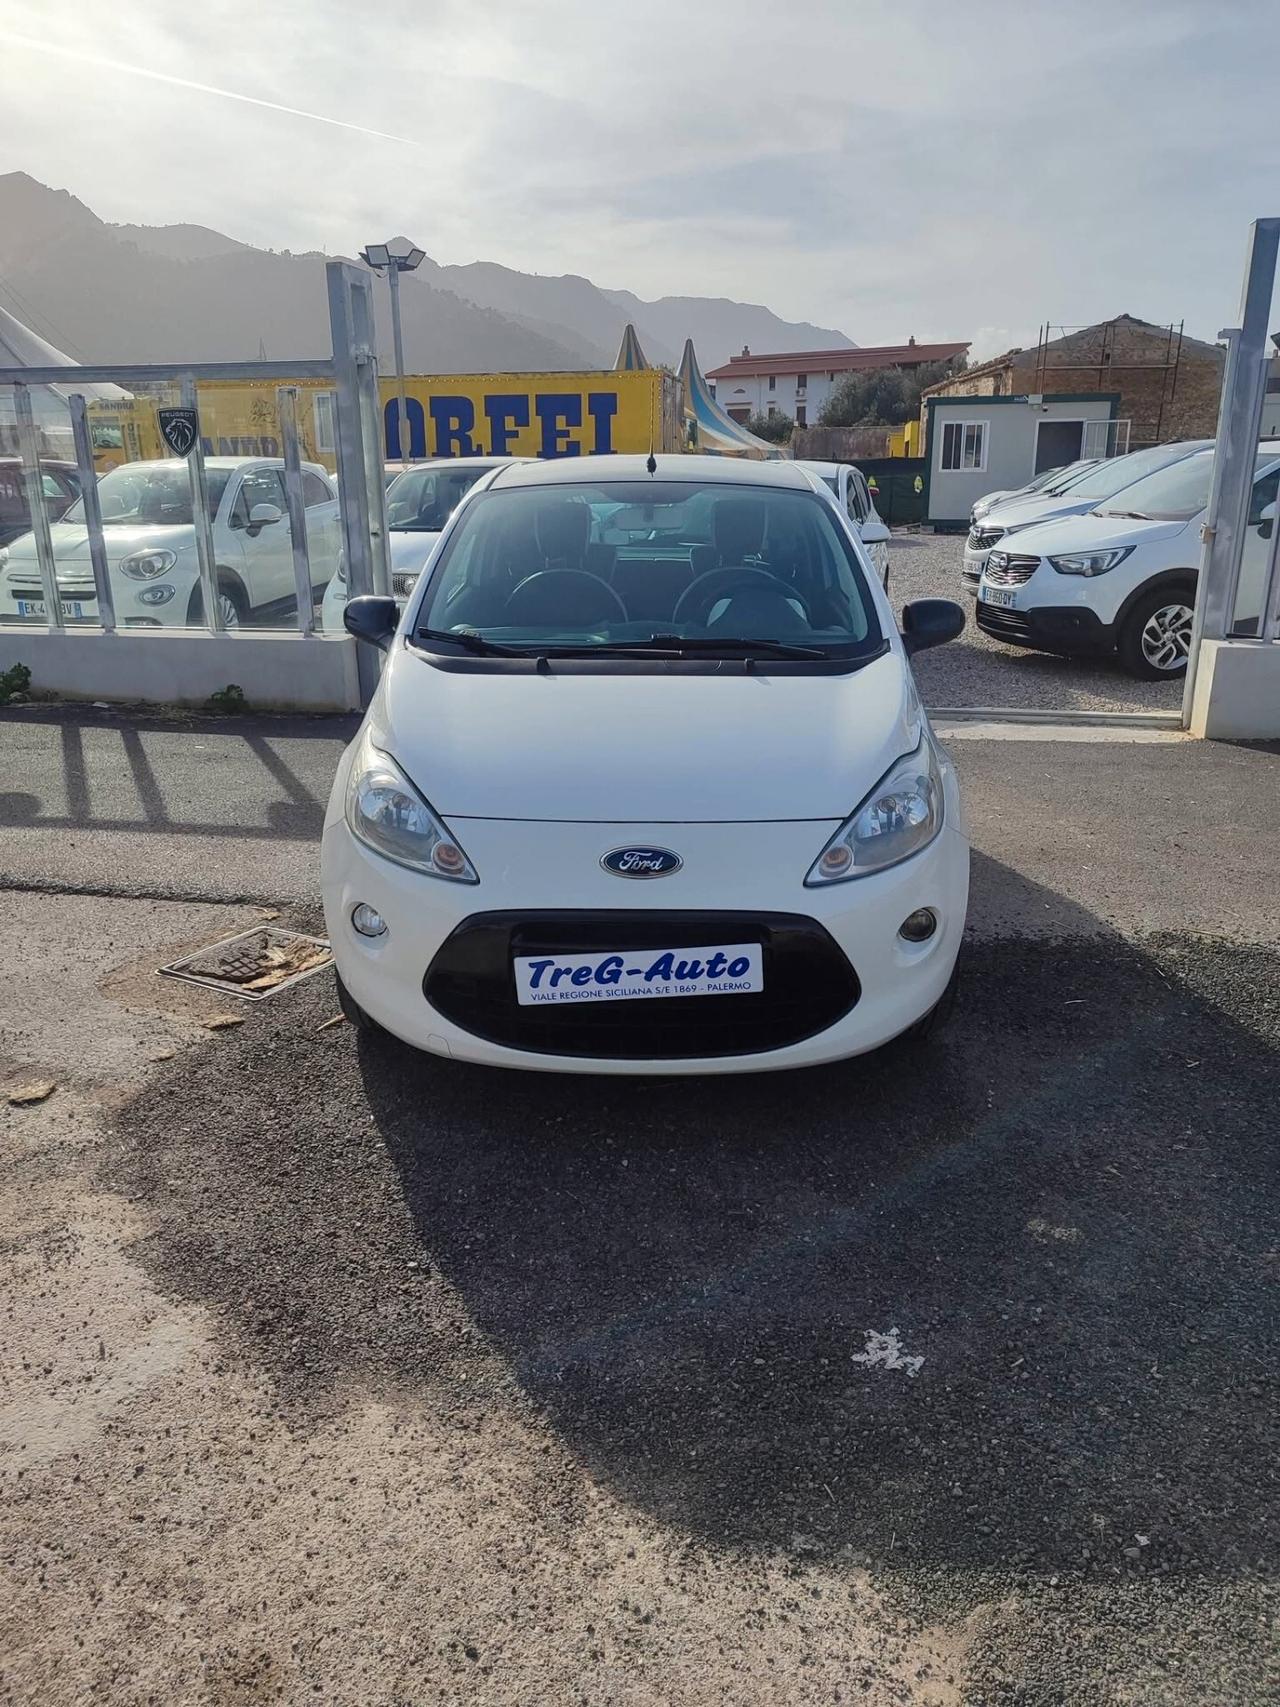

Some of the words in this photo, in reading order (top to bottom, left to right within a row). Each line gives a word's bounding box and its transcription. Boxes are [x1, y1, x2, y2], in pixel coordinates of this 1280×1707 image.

[384, 393, 618, 459] ORFEI
[619, 851, 664, 870] Ford
[528, 952, 751, 989] TreG-Auto
[530, 992, 558, 1001] VIALE
[559, 989, 603, 1000] REGIONE
[605, 985, 653, 998] SICILIANA
[655, 985, 671, 995] S/E
[674, 984, 697, 994] 1869
[707, 981, 752, 992] PALERMO
